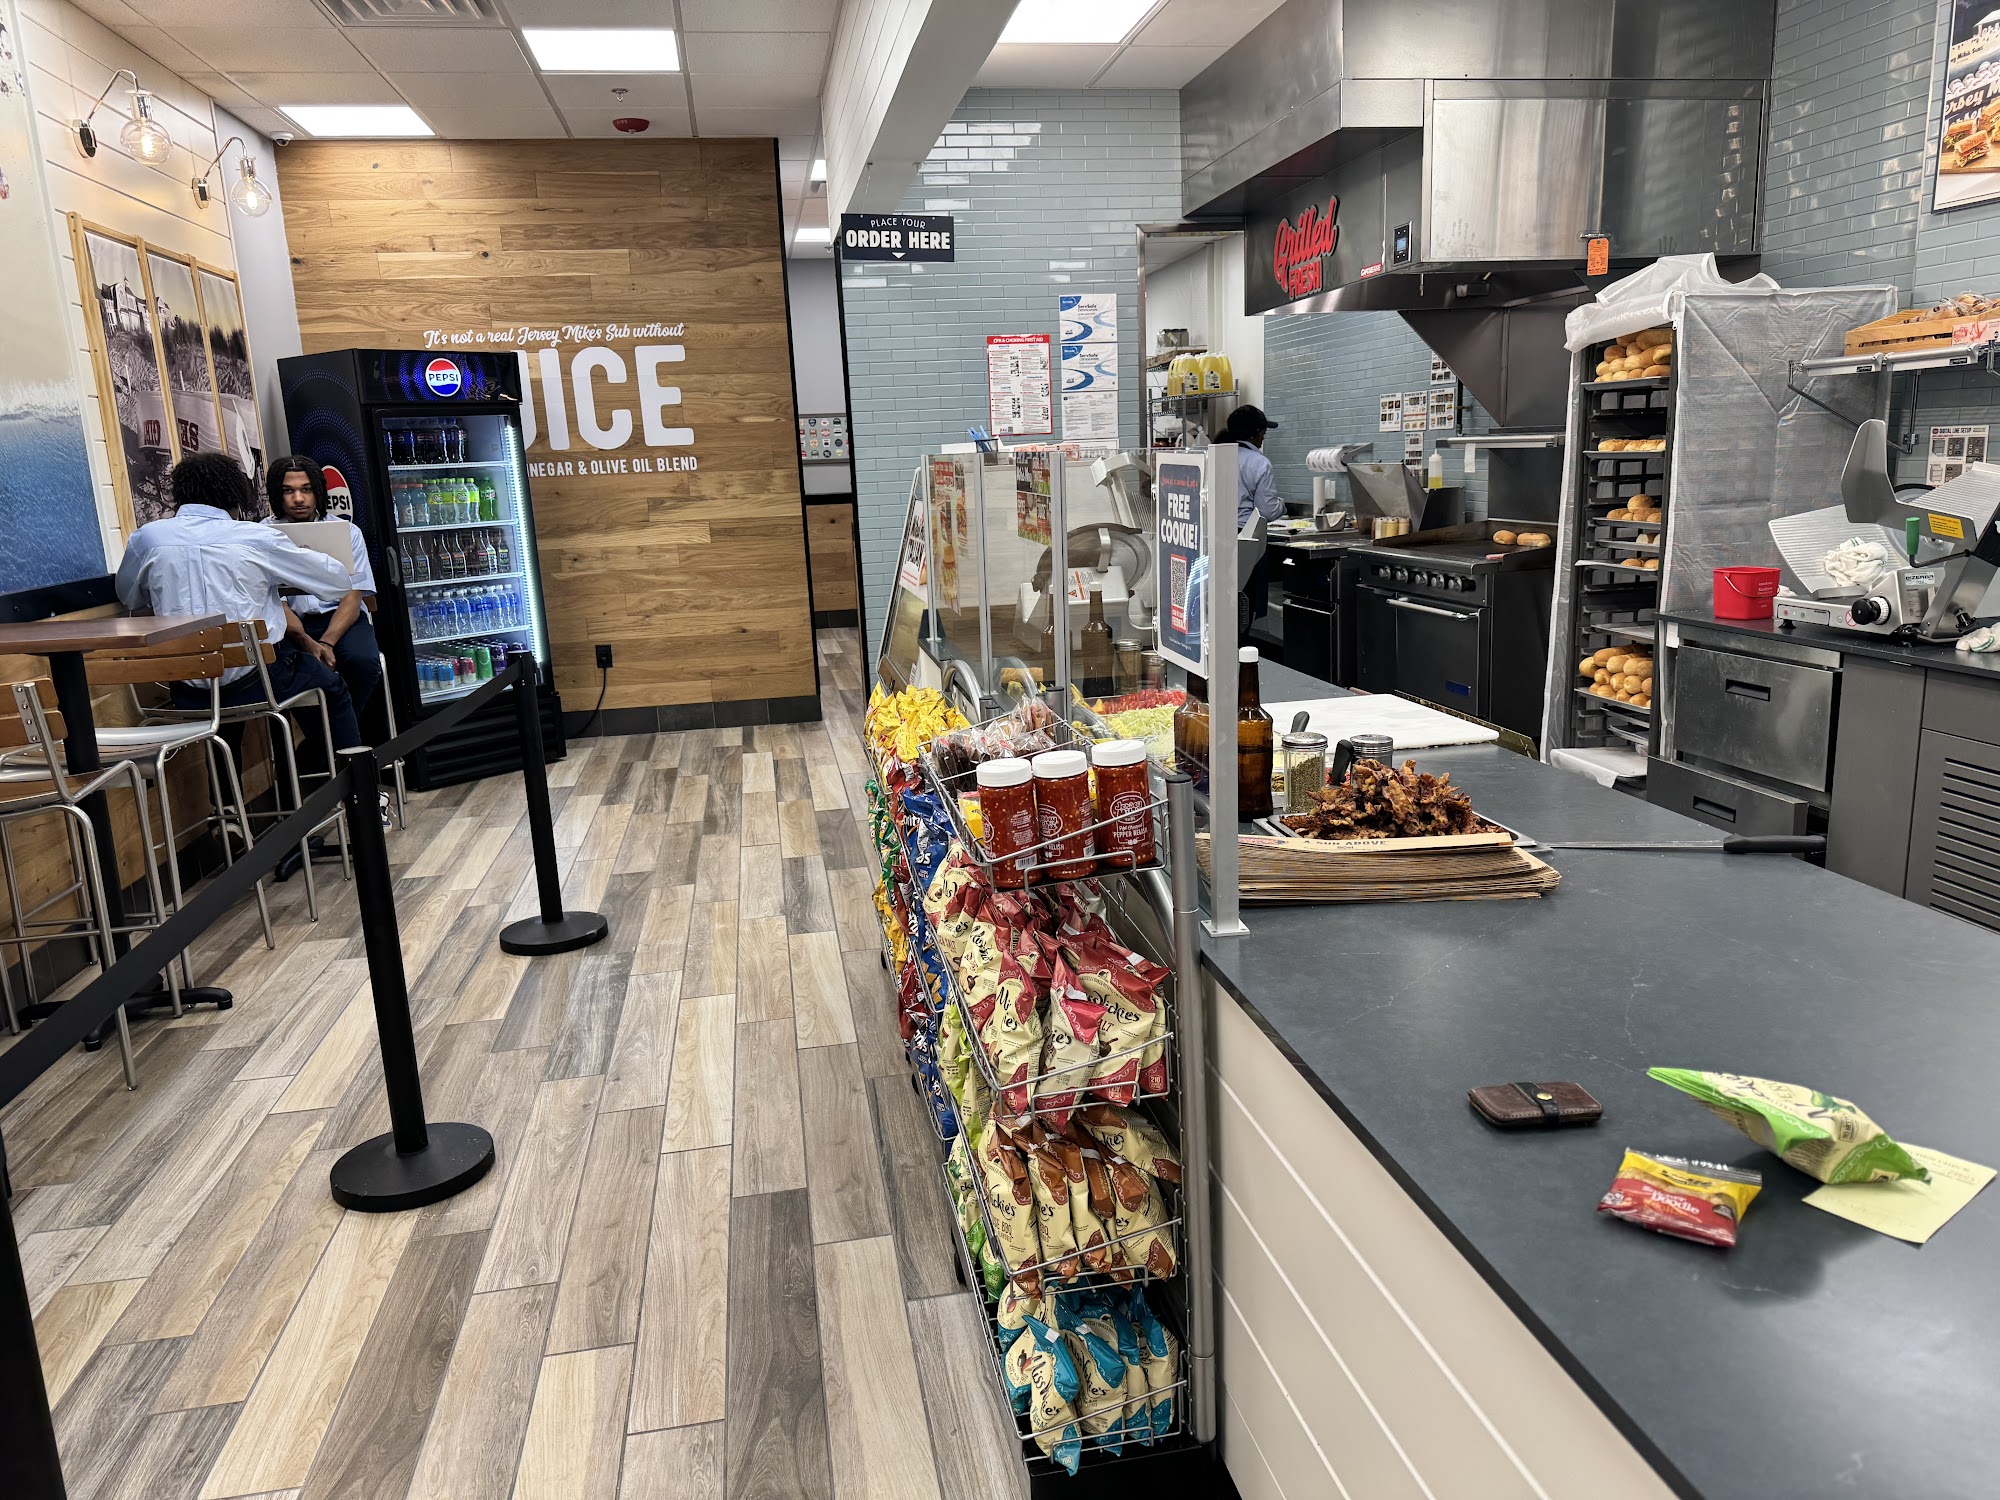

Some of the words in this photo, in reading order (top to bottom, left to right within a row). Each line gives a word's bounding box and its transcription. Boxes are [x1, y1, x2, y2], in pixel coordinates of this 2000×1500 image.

[870, 217, 897, 228] PLACE
[901, 218, 926, 229] YOUR
[846, 229, 902, 248] ORDER
[908, 231, 951, 250] HERE
[1274, 196, 1336, 290] Grilled
[1289, 260, 1321, 299] FRESH
[423, 328, 448, 349] It's
[450, 329, 474, 344] not
[475, 332, 486, 343] a
[487, 327, 514, 343] real
[517, 326, 562, 348] Jersey
[561, 323, 602, 343] Mike's
[605, 323, 630, 342] Sub
[633, 322, 685, 337] without
[428, 373, 459, 382] PEPSI
[526, 461, 574, 478] INEGAR
[578, 461, 588, 475] &
[590, 459, 628, 474] OLIVE
[632, 458, 653, 473] OIL
[656, 456, 698, 472] BLEND
[327, 495, 351, 511] EPSI
[1167, 492, 1191, 520] FREE
[1160, 518, 1198, 551] COOKIE!
[1113, 830, 1132, 838] PEPPER
[1651, 1191, 1700, 1215] Doodle
